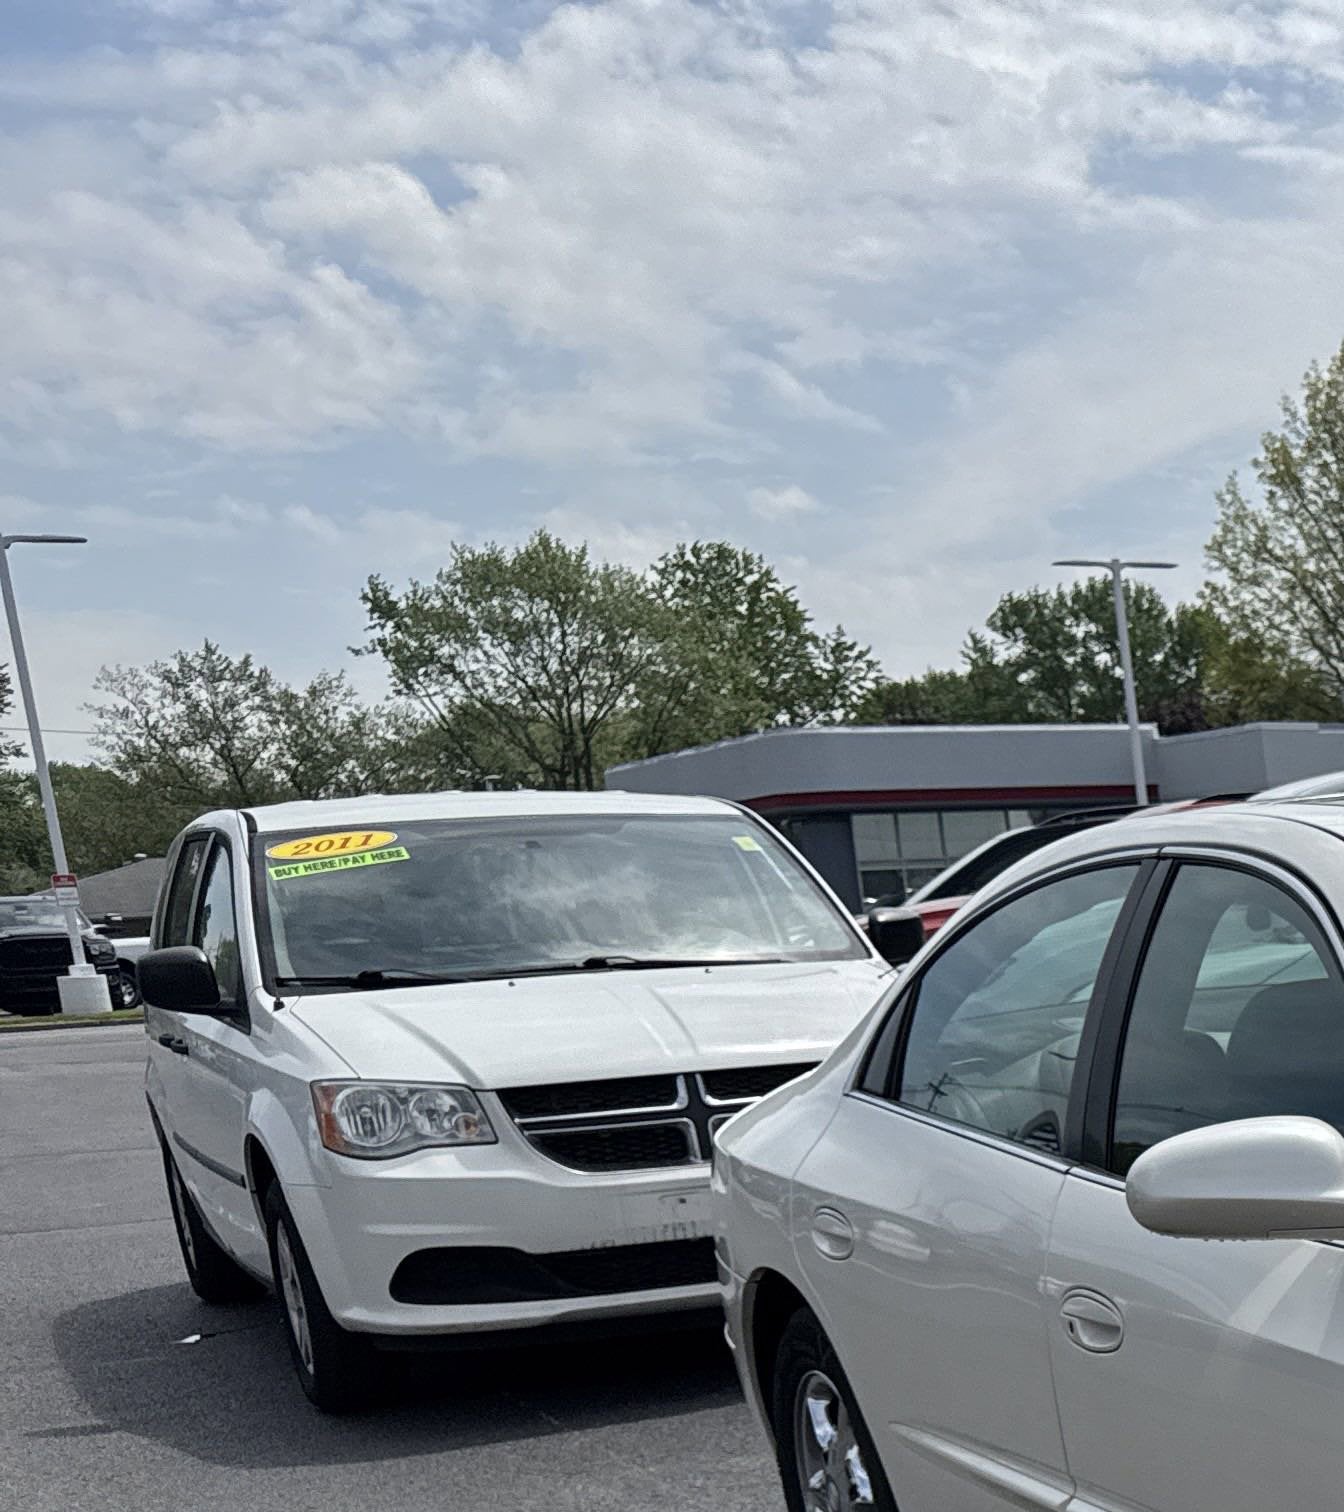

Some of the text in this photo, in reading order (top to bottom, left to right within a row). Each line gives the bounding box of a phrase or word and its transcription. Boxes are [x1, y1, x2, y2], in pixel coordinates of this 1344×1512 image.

[291, 834, 374, 856] 2011
[274, 849, 405, 878] BUY HERE/PAY HERE
